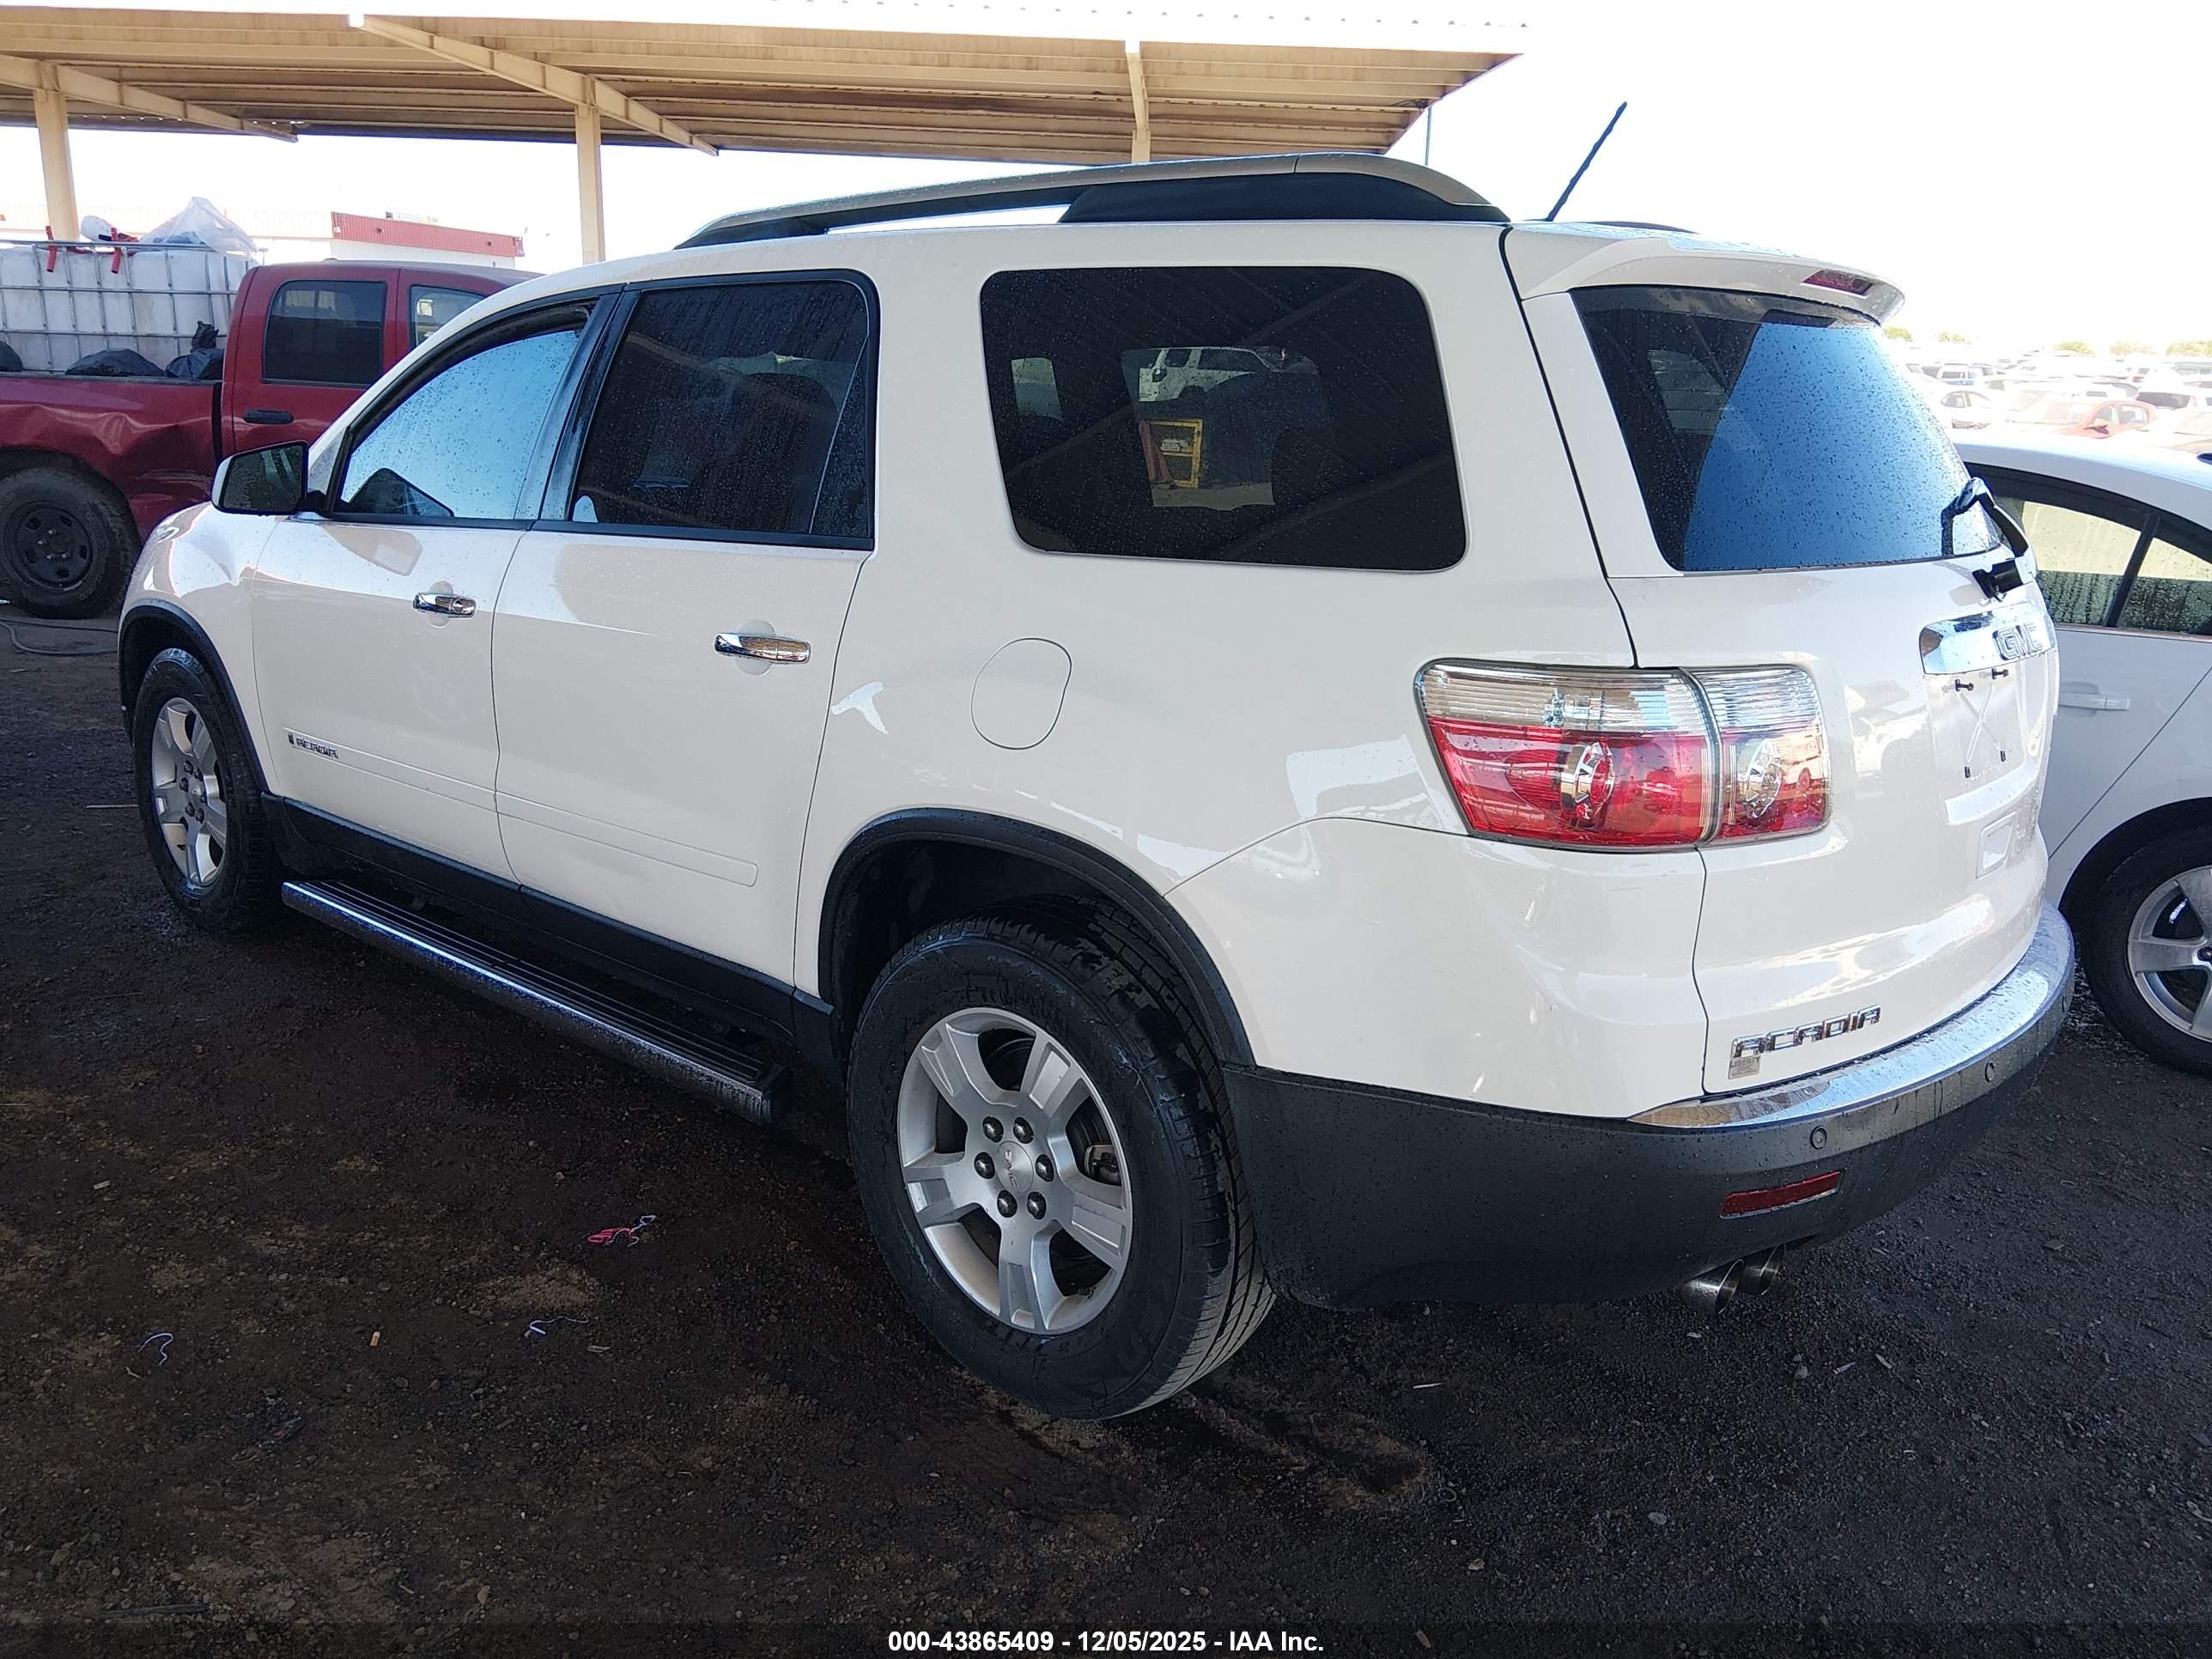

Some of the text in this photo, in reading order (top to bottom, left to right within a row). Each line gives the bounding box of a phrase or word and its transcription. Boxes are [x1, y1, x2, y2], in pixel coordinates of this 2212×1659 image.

[1992, 623, 2042, 660] GMC
[296, 736, 338, 758] ACADIA
[1730, 1005, 1881, 1058] ACADIA
